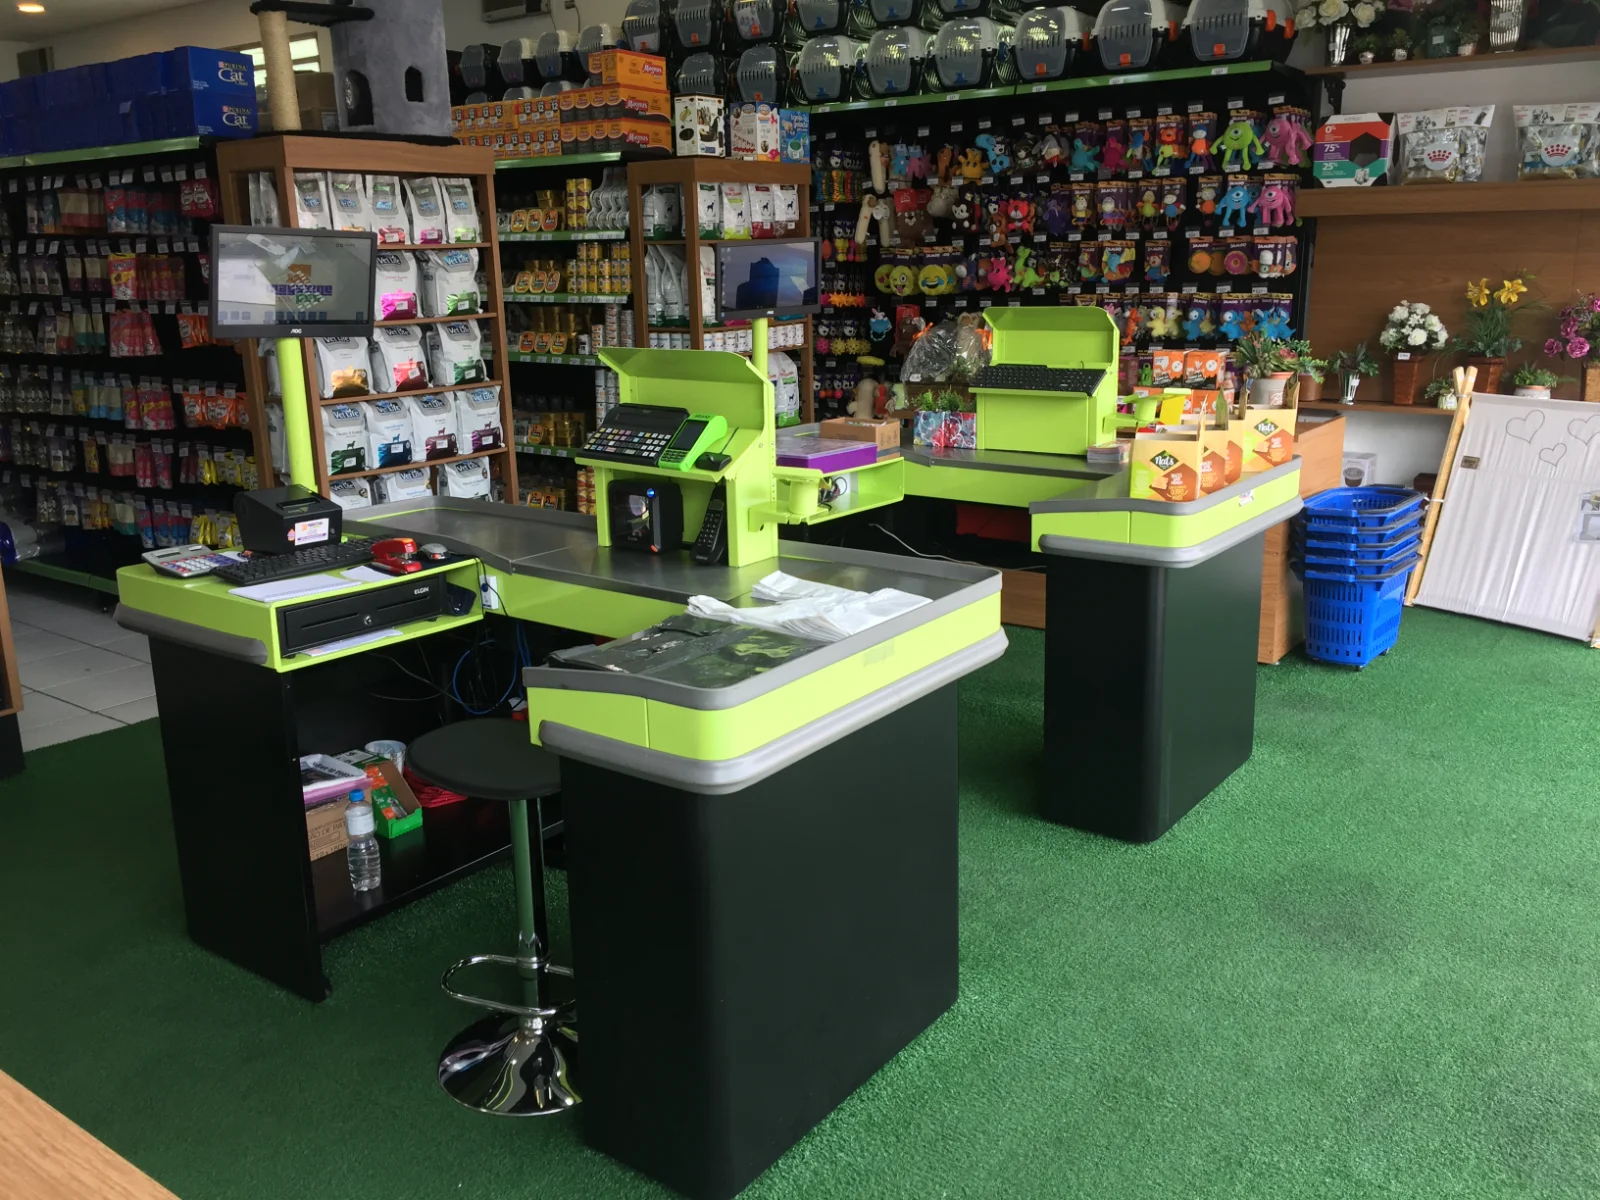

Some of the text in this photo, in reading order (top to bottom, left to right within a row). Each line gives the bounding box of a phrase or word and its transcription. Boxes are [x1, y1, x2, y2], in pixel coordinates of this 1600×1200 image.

[218, 68, 244, 82] Cat
[626, 100, 648, 111] Magnus
[222, 112, 248, 127] Cat
[1325, 126, 1336, 134] 0%
[1324, 144, 1340, 152] 75%
[445, 258, 458, 266] Vet
[333, 410, 360, 419] Vet Life
